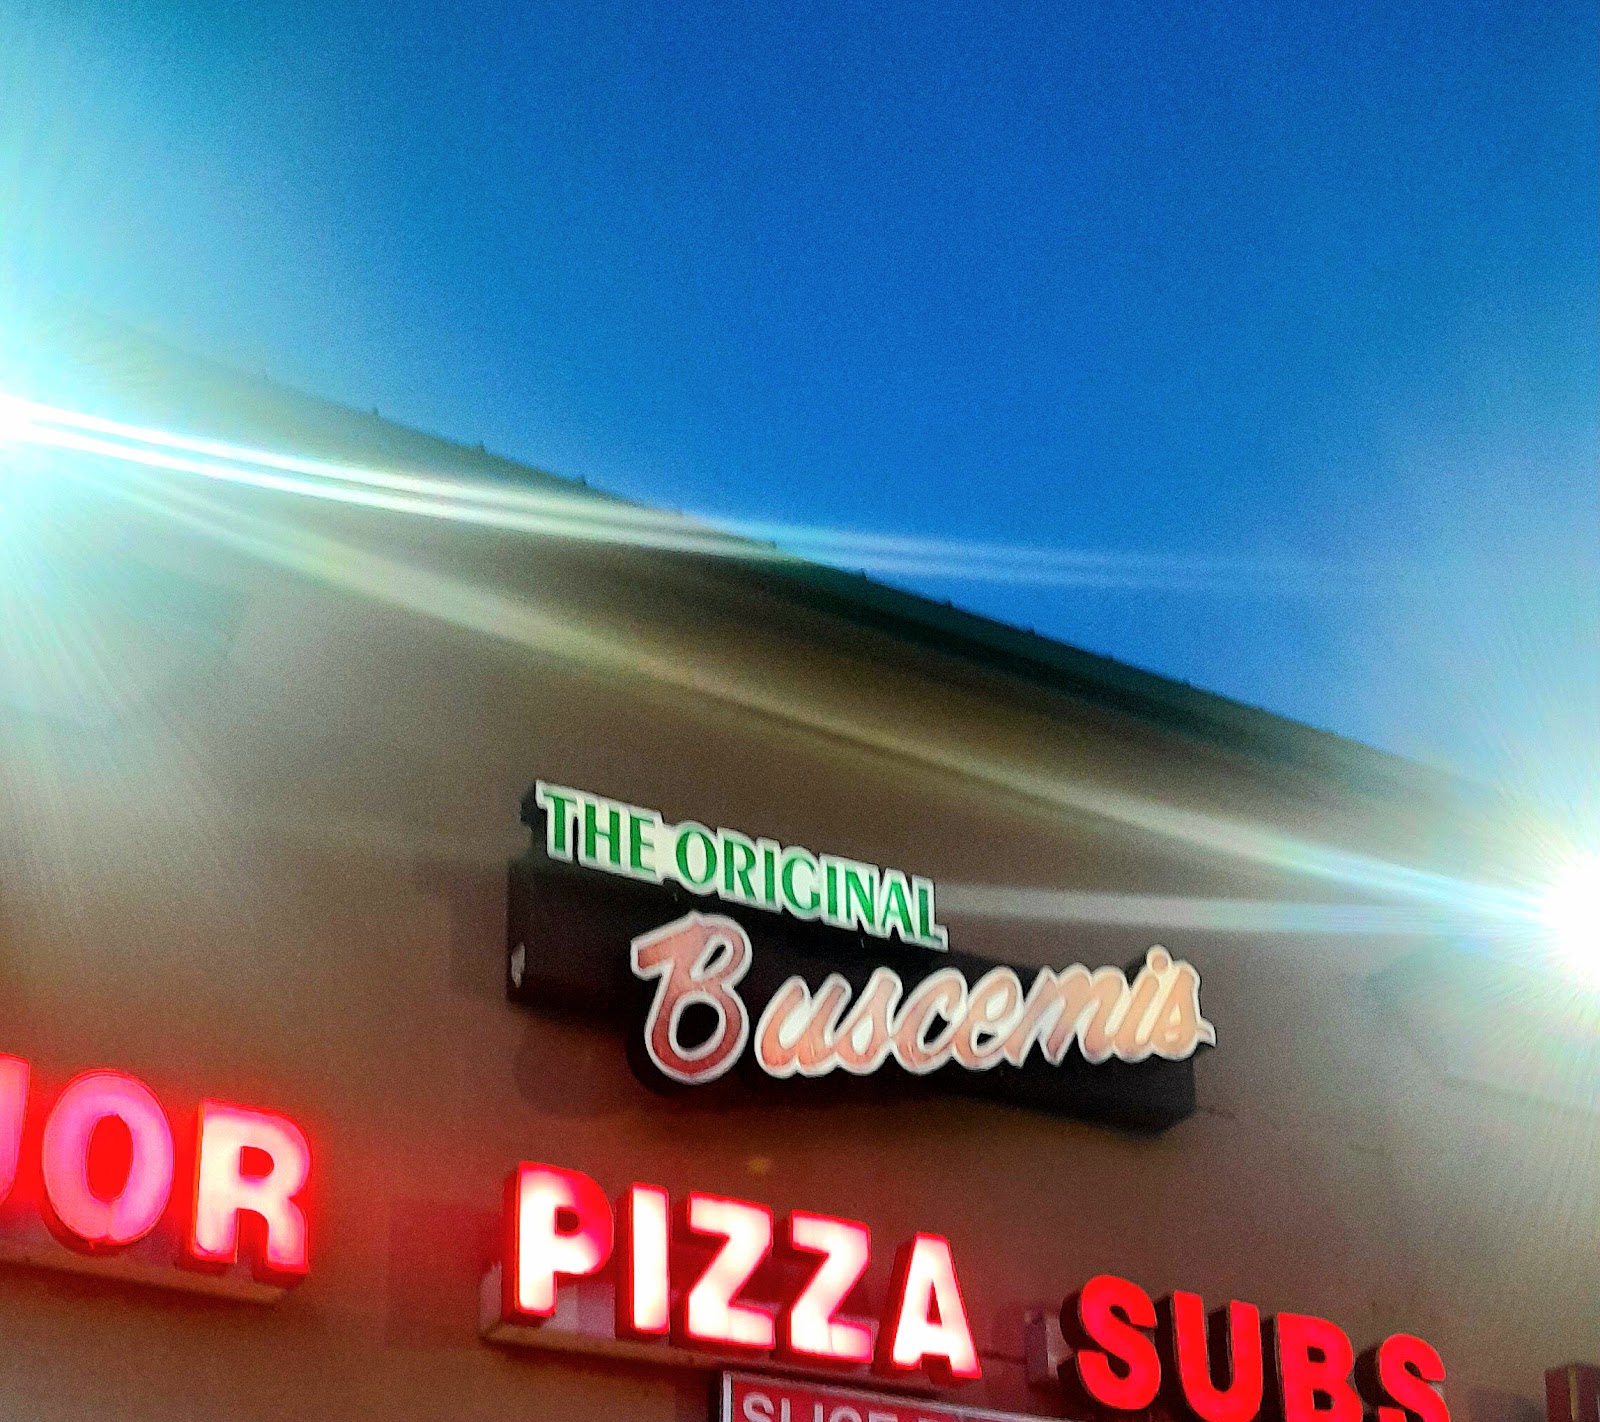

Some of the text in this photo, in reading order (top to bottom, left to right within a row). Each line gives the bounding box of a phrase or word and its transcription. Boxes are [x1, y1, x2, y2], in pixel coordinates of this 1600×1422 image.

[537, 784, 949, 950] THE ORIGINAL
[0, 1053, 311, 1276] OR
[513, 1160, 982, 1381] PIZZA
